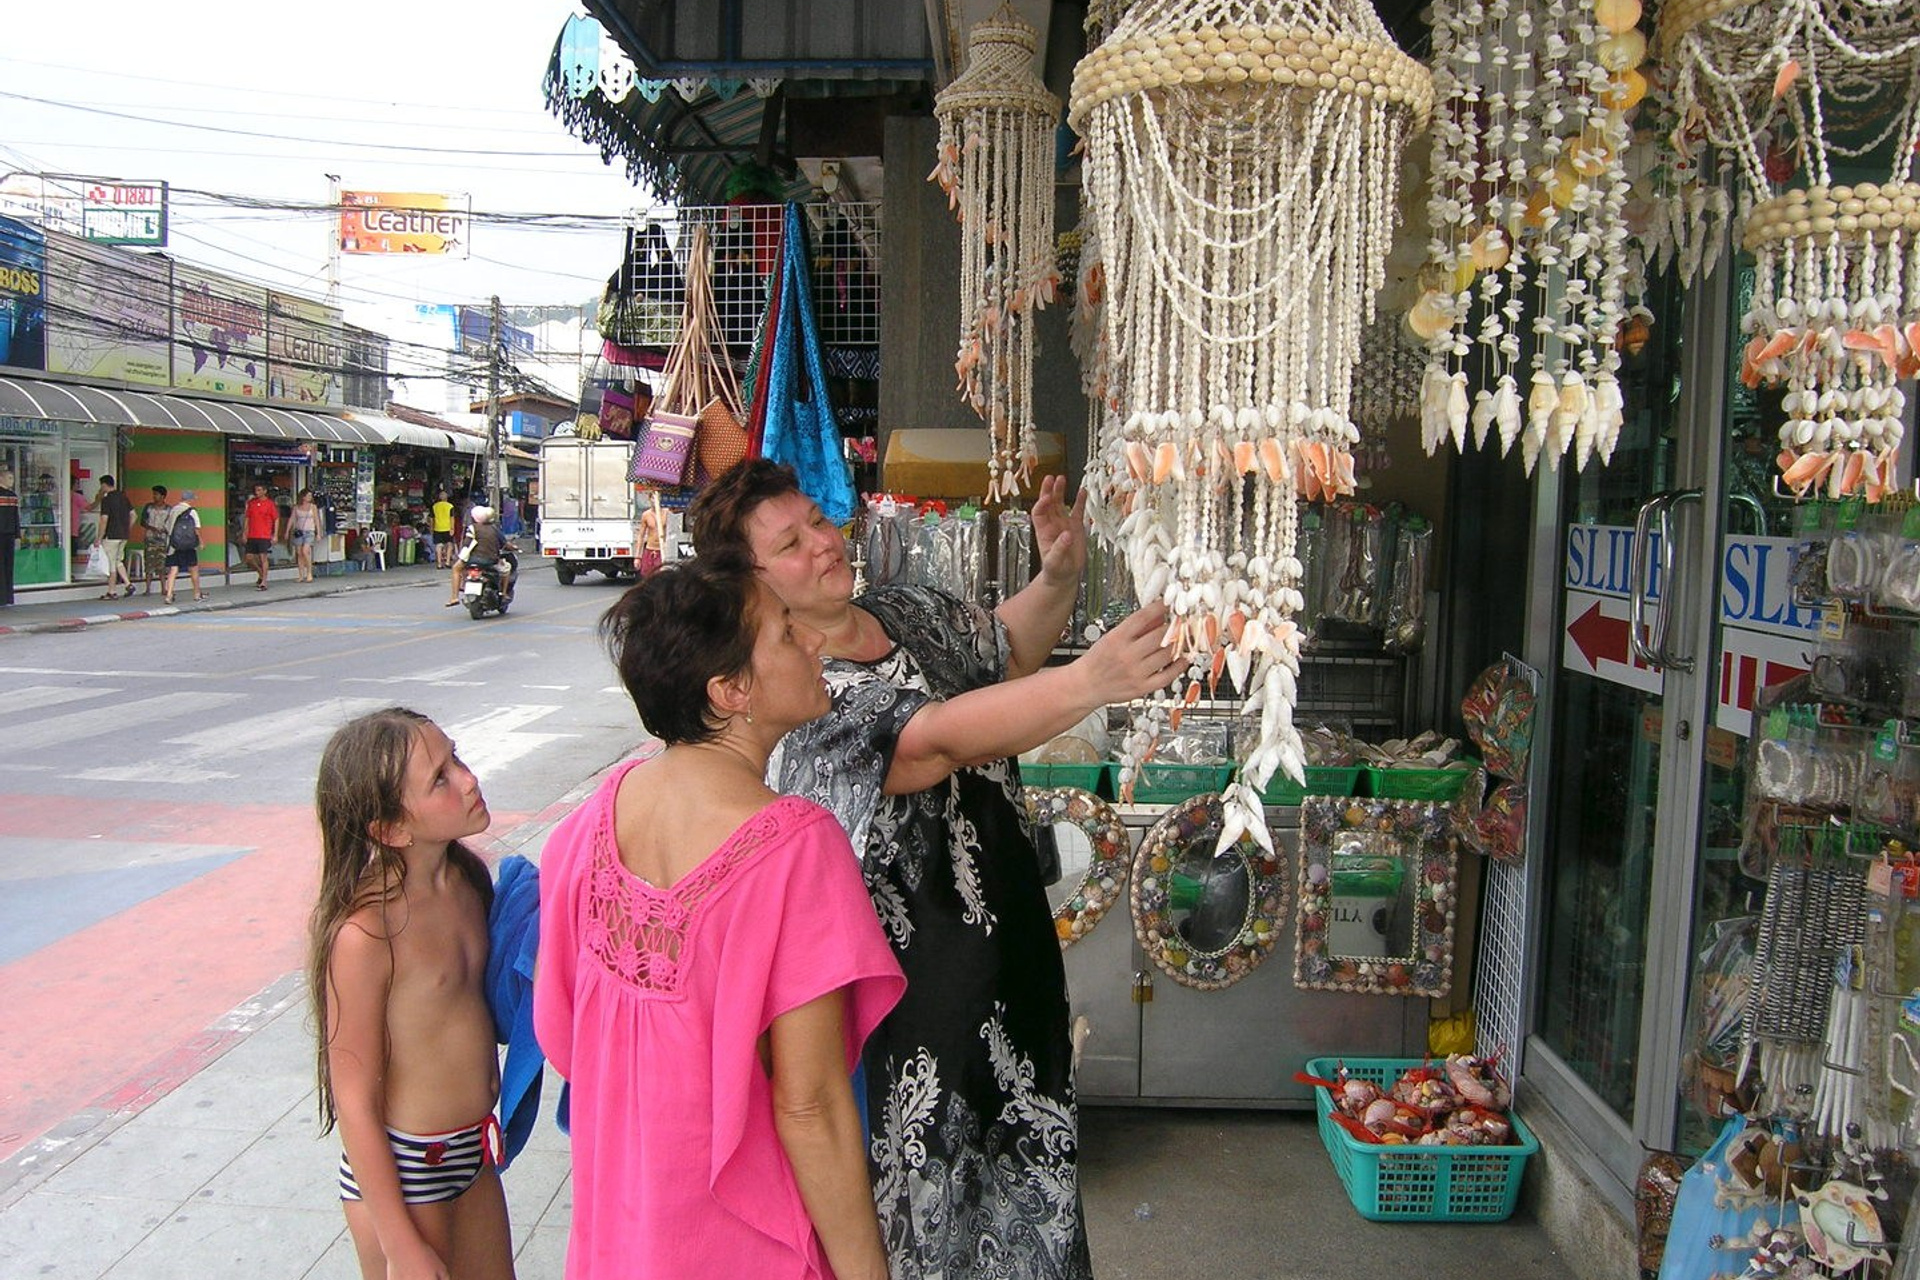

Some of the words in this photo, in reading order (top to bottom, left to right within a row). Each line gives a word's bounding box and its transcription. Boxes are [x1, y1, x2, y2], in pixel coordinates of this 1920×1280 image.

[363, 208, 463, 235] Leather
[0, 265, 40, 296] BOSS
[1722, 542, 1822, 630] SLI
